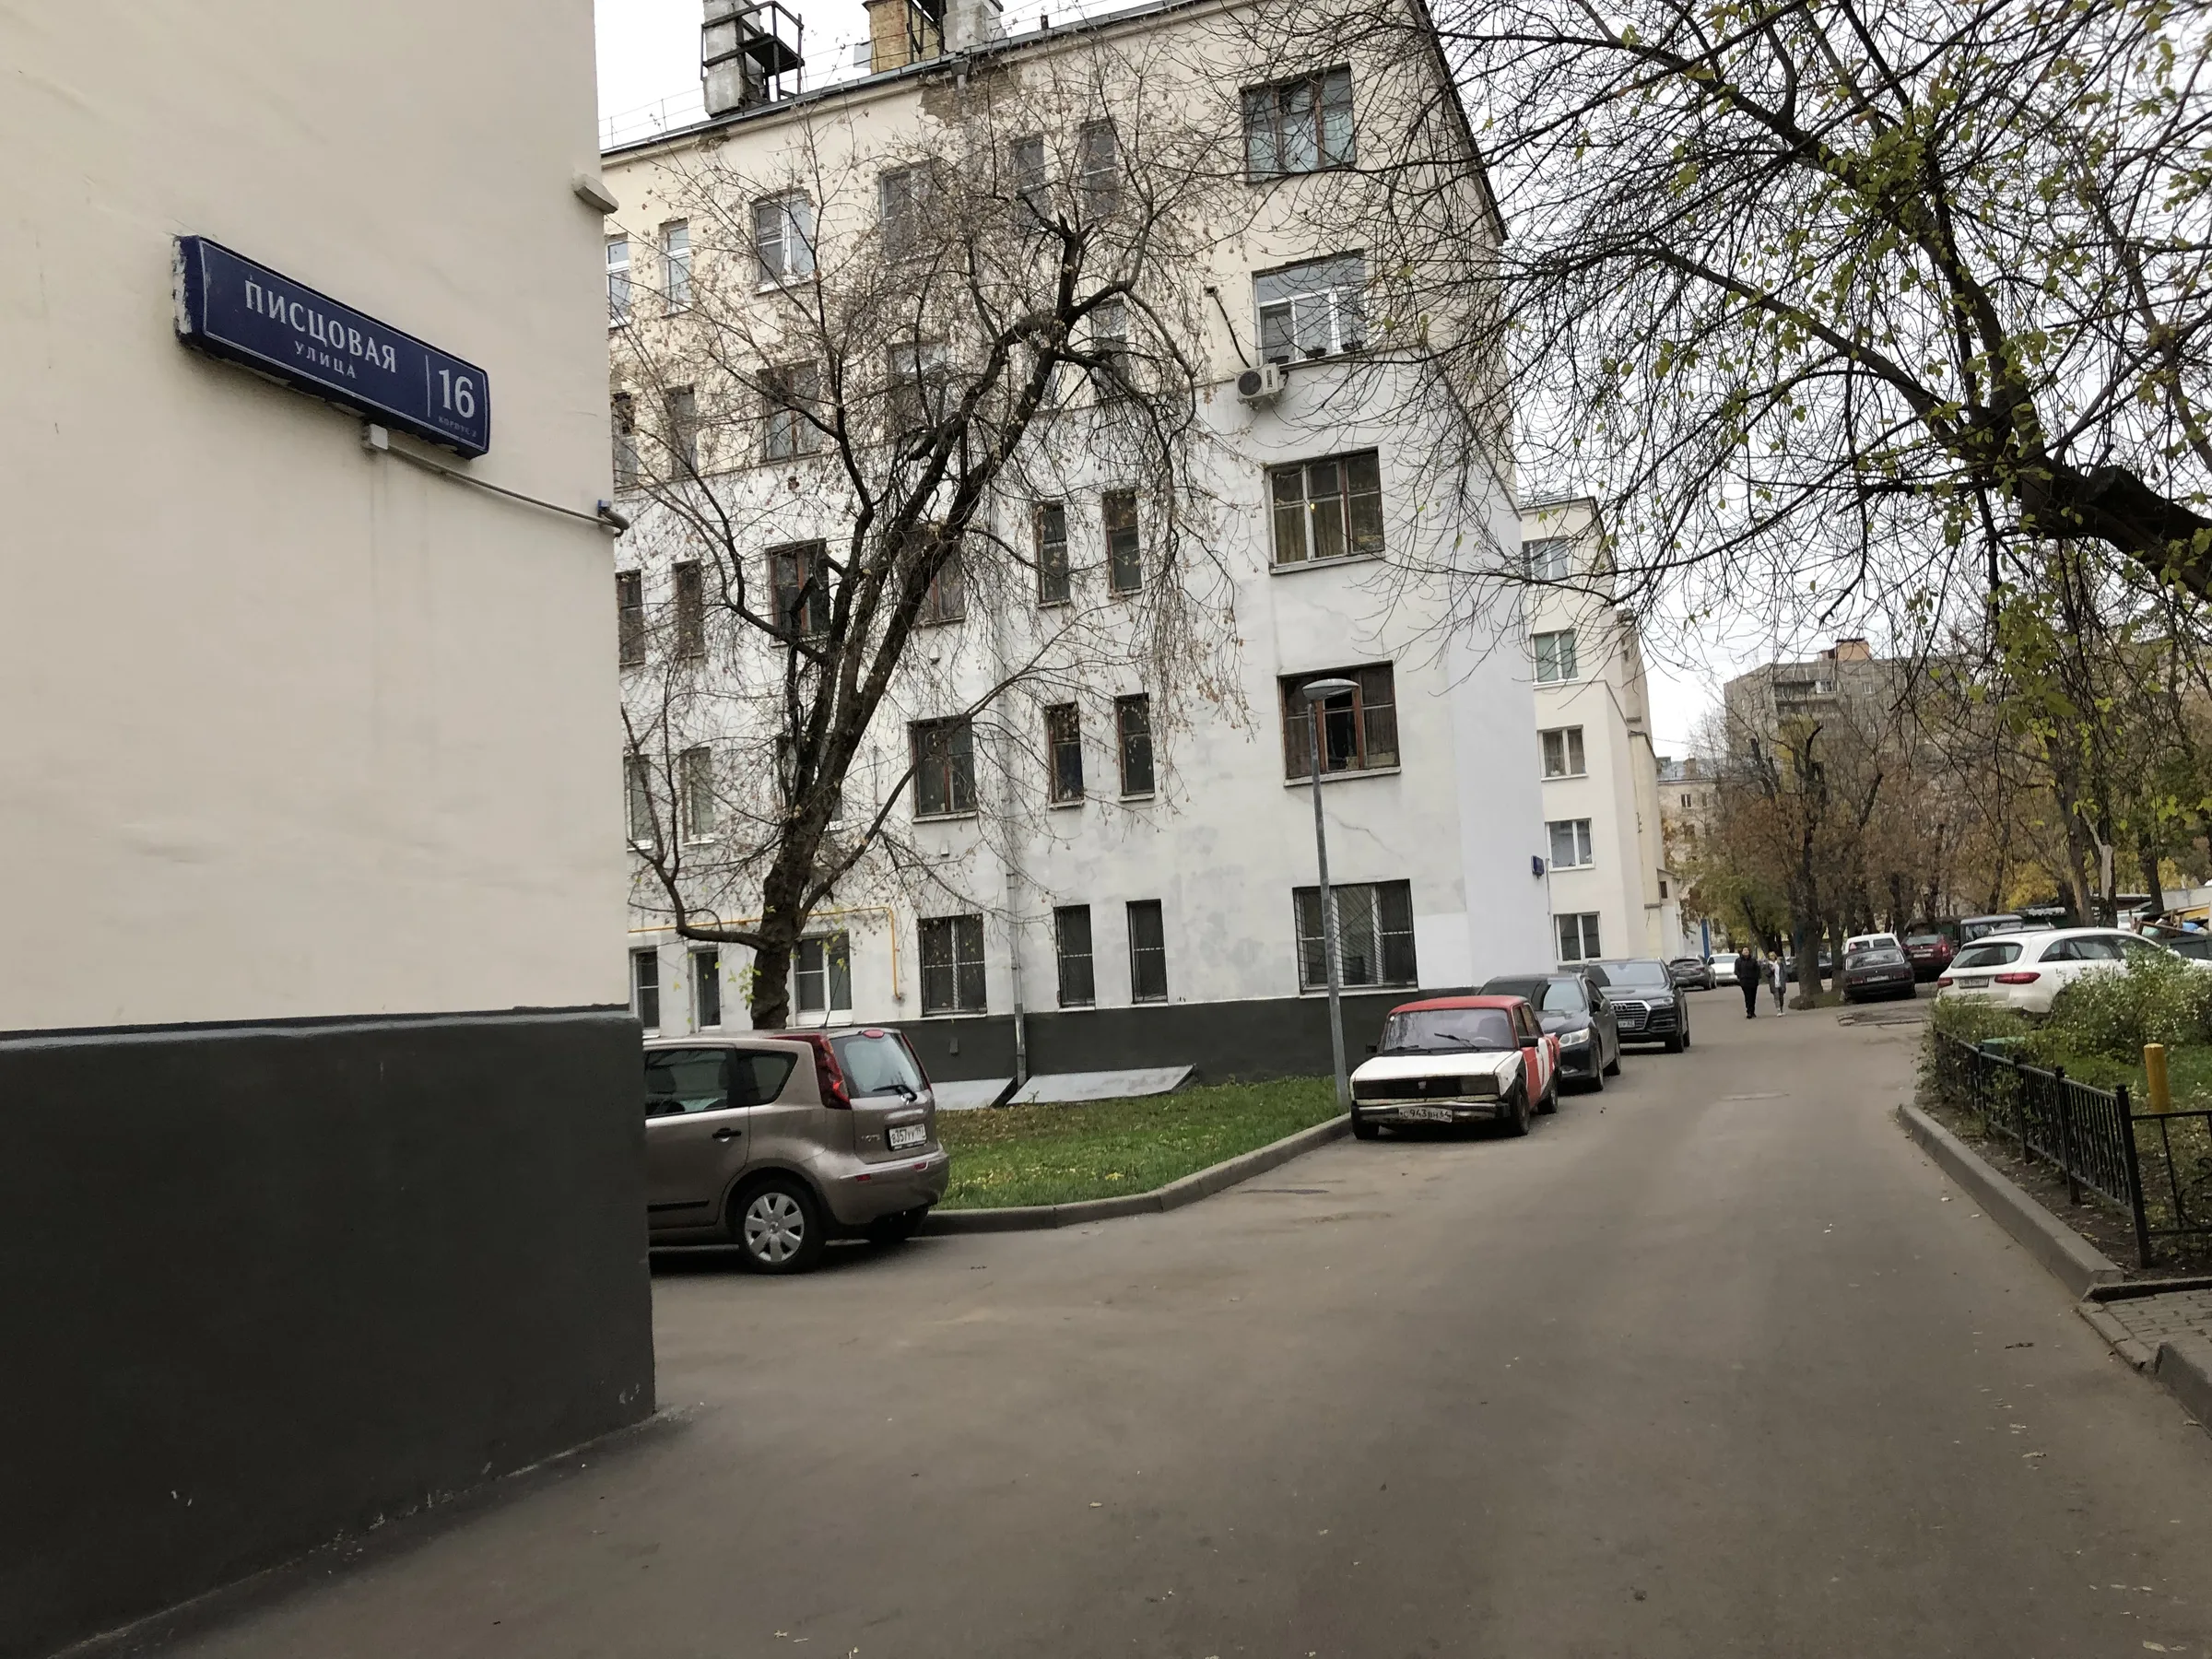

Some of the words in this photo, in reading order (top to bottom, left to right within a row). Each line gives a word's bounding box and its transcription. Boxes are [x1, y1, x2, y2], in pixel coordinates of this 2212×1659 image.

[245, 279, 396, 373] ПИСЦОВАЯ
[295, 340, 357, 379] УЛИЦА
[438, 369, 476, 418] 16
